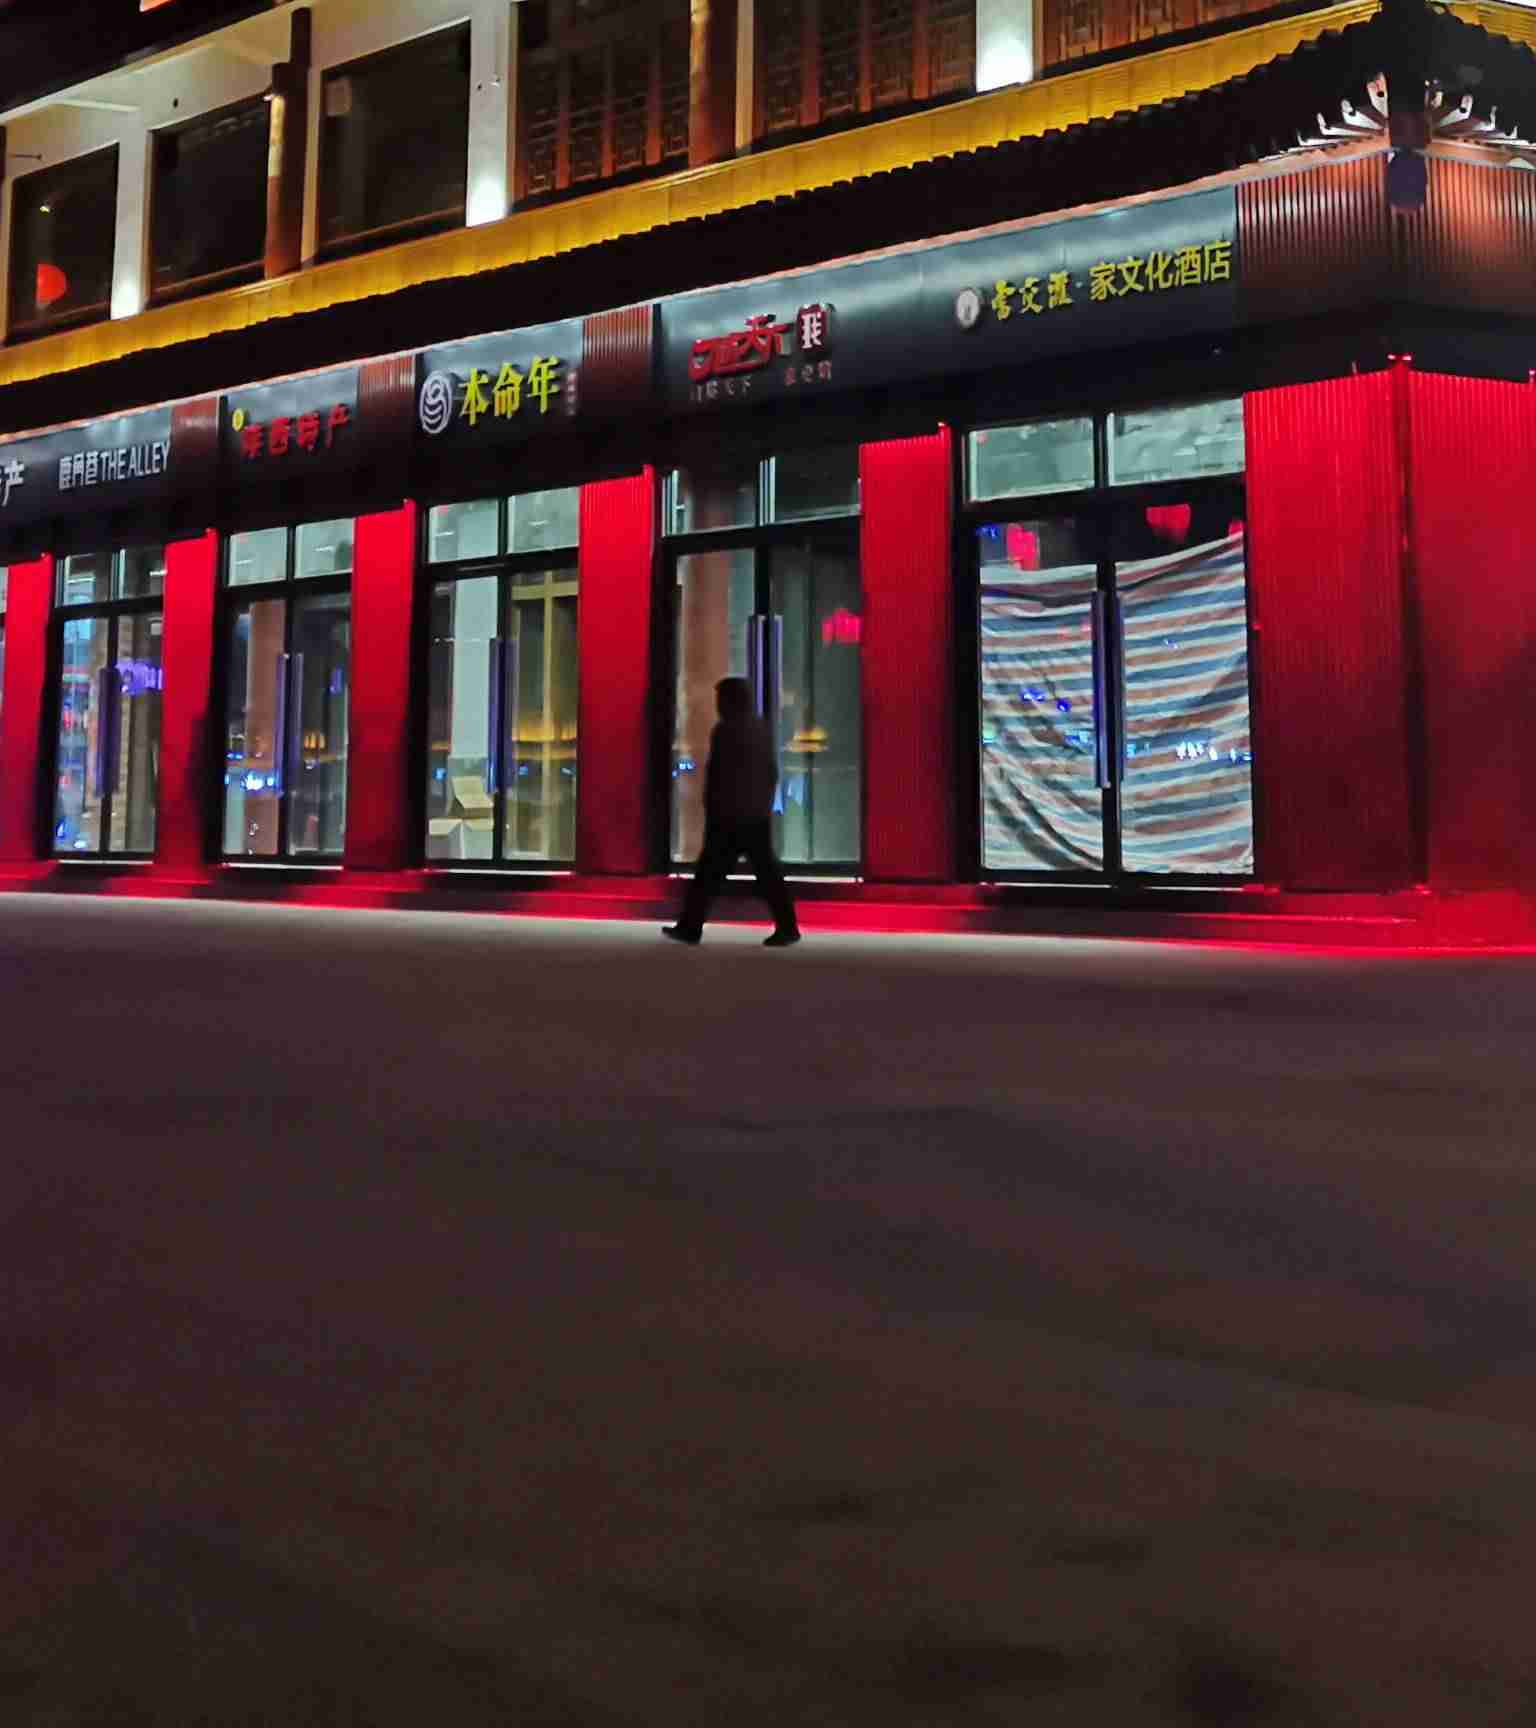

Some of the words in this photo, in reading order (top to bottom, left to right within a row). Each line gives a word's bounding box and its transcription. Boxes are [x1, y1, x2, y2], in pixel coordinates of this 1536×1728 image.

[1088, 239, 1233, 303] 家文化酒店
[458, 354, 561, 427] 本命年
[100, 448, 127, 483] THE
[127, 439, 172, 478] ALLEY
